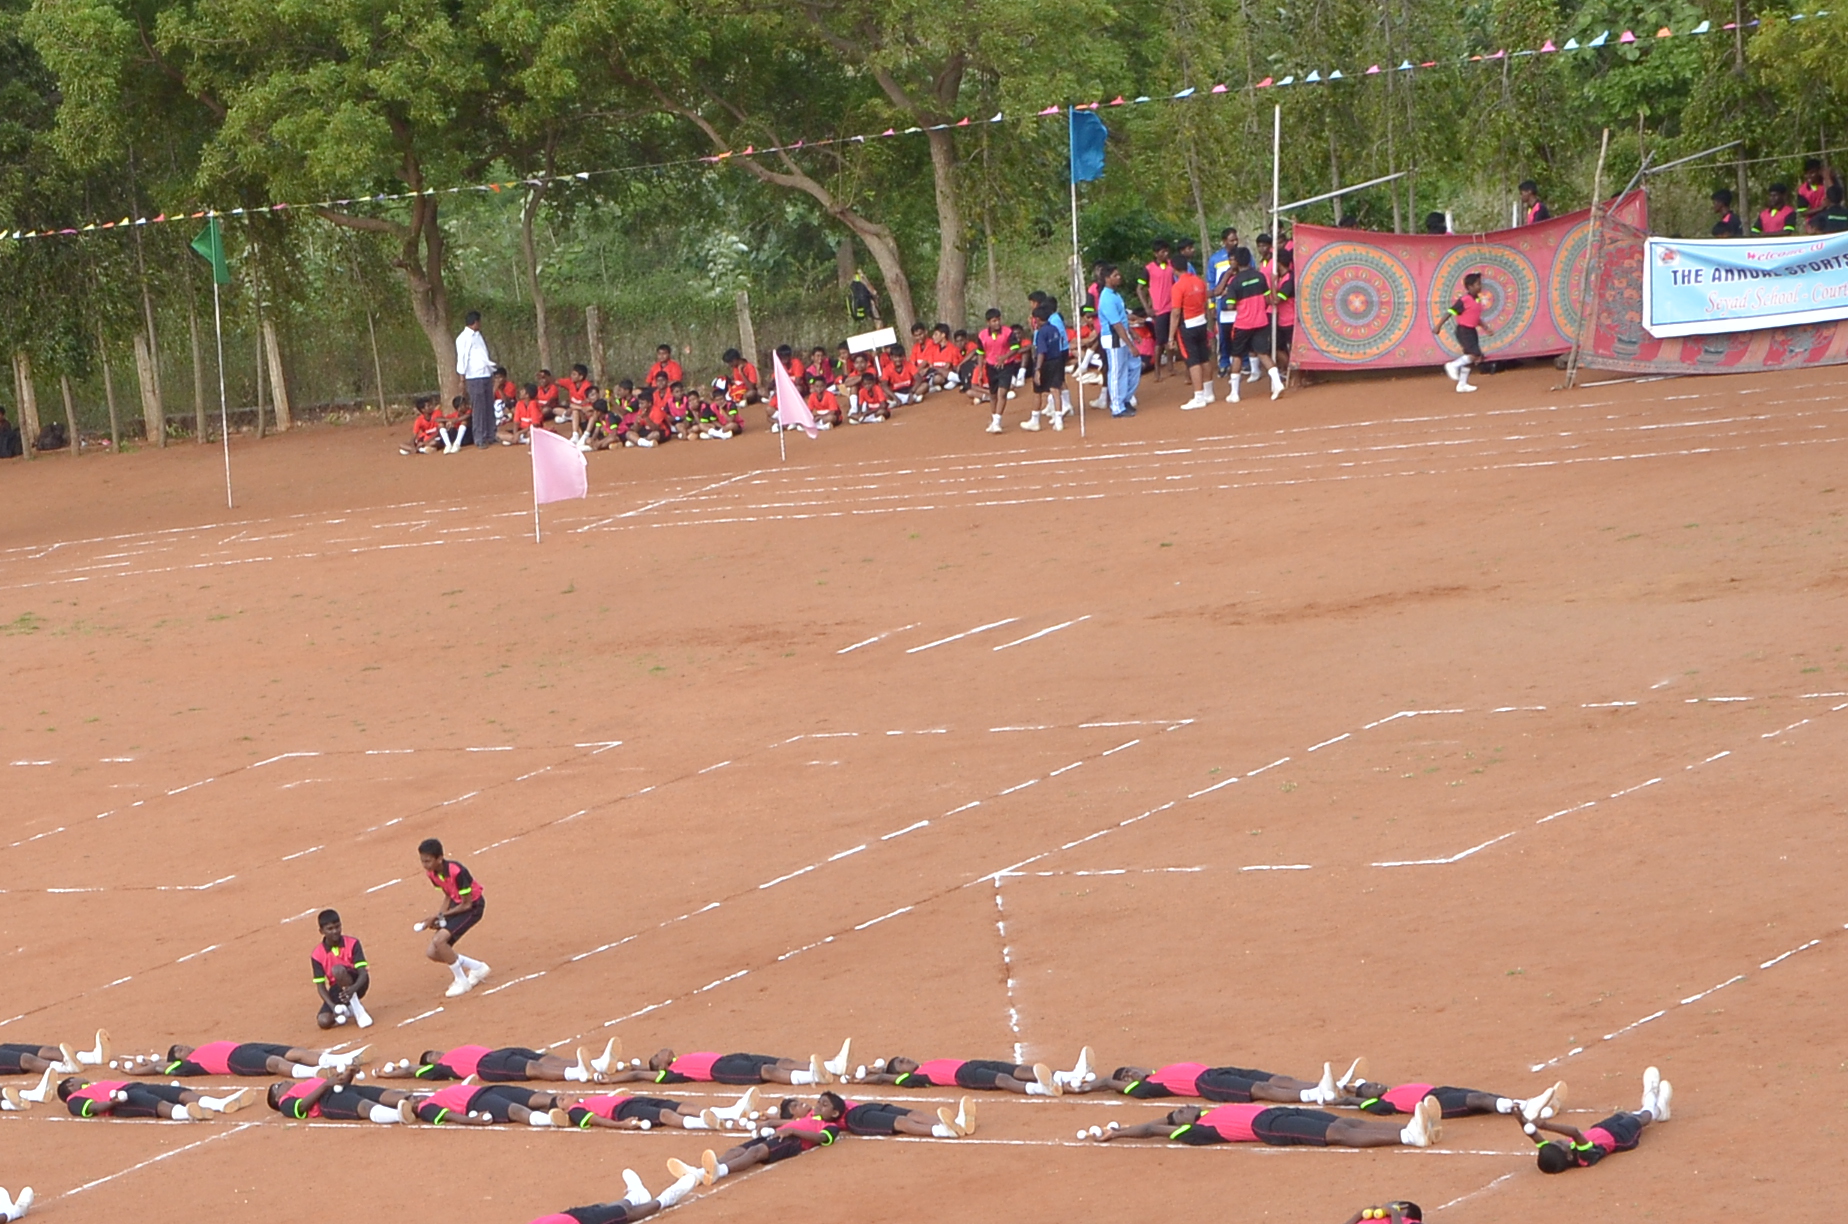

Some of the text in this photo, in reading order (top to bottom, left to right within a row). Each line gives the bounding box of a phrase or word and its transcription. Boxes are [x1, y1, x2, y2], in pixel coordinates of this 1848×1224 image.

[1671, 269, 1703, 286] THE
[1784, 253, 1848, 276] SPORTS
[1751, 284, 1802, 310] School
